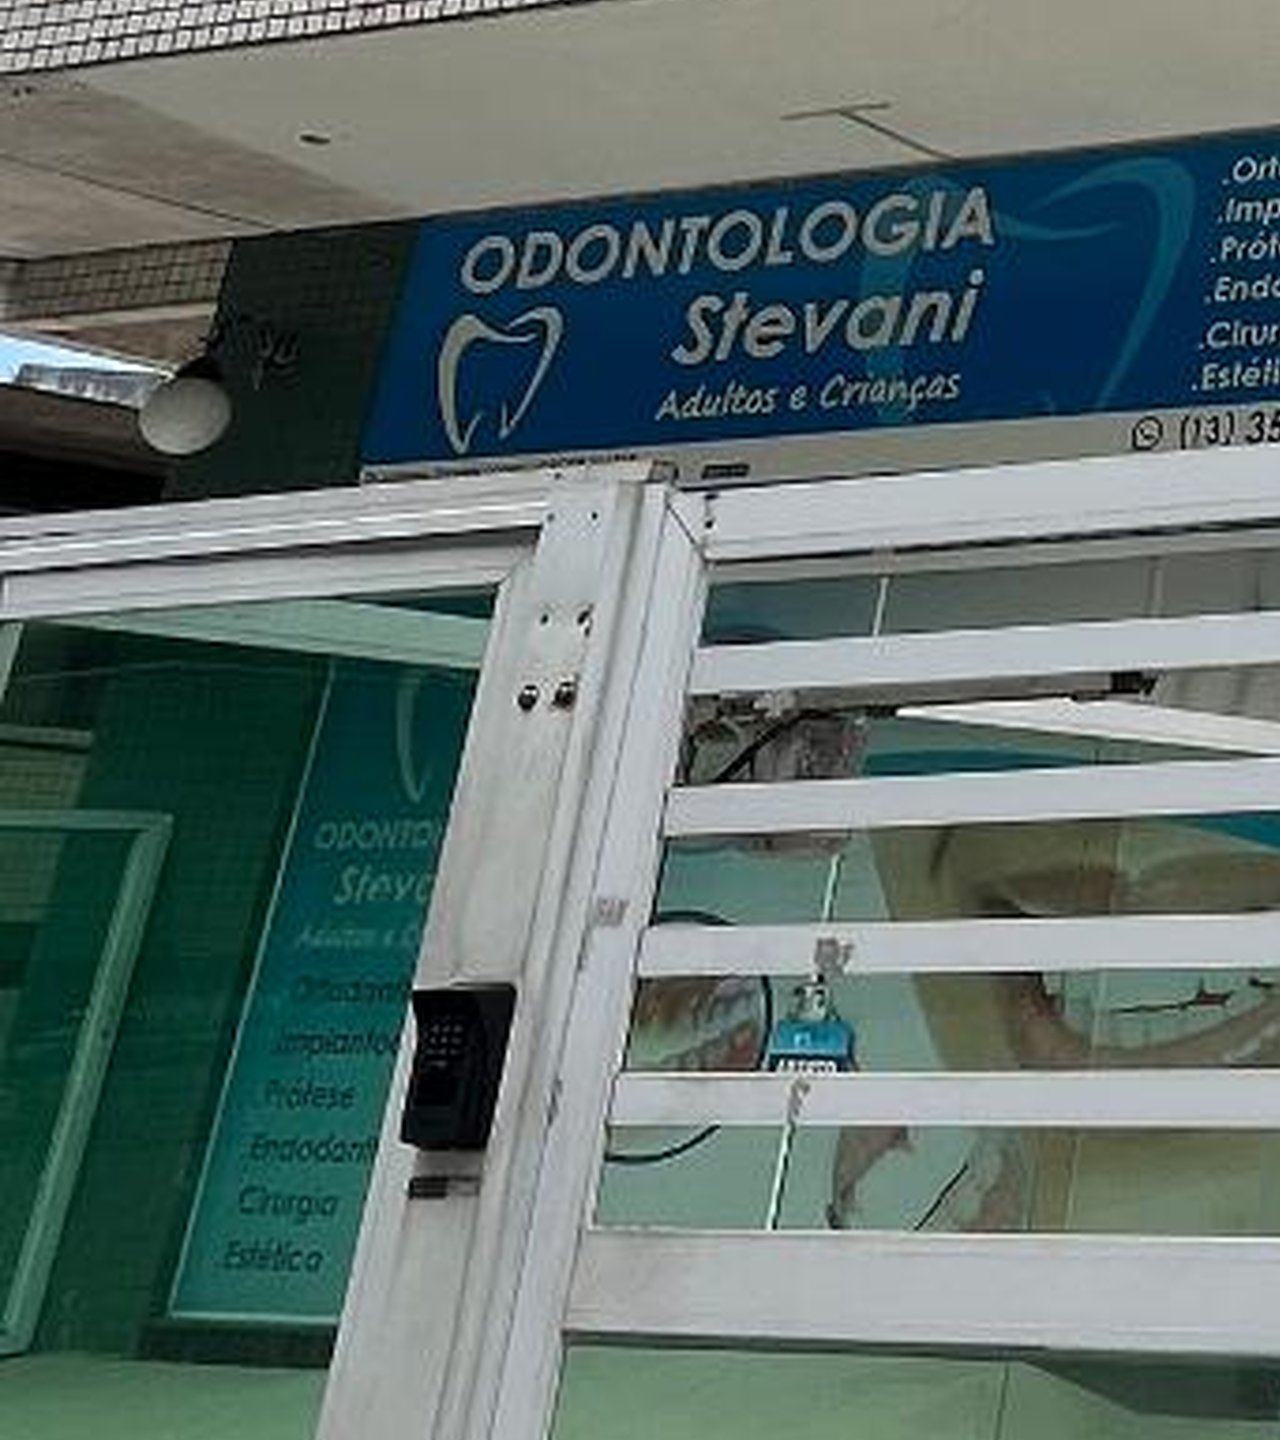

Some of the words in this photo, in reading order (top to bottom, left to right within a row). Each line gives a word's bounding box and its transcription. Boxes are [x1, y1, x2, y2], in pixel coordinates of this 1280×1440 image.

[460, 187, 995, 295] ODONTOLOGIA
[671, 268, 985, 365] Stevani
[655, 382, 777, 421] Adultos
[789, 392, 805, 409] e
[819, 372, 960, 416] Crianças
[1181, 415, 1236, 449] (13)
